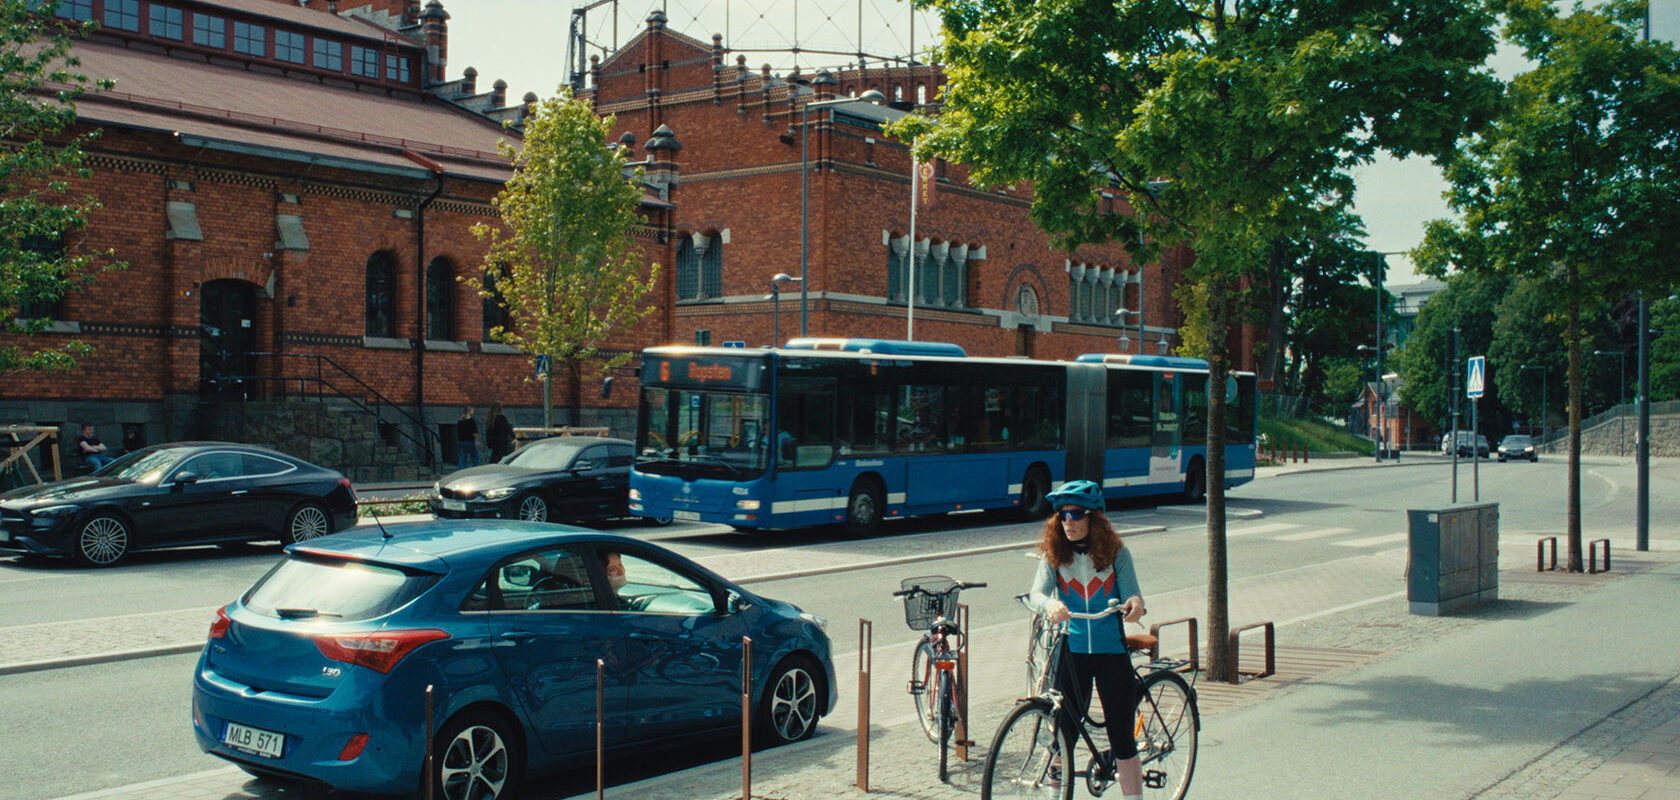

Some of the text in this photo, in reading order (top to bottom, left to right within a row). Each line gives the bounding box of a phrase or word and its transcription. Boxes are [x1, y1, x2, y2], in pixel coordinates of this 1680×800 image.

[660, 361, 670, 382] 6
[229, 727, 278, 752] MLB 571
